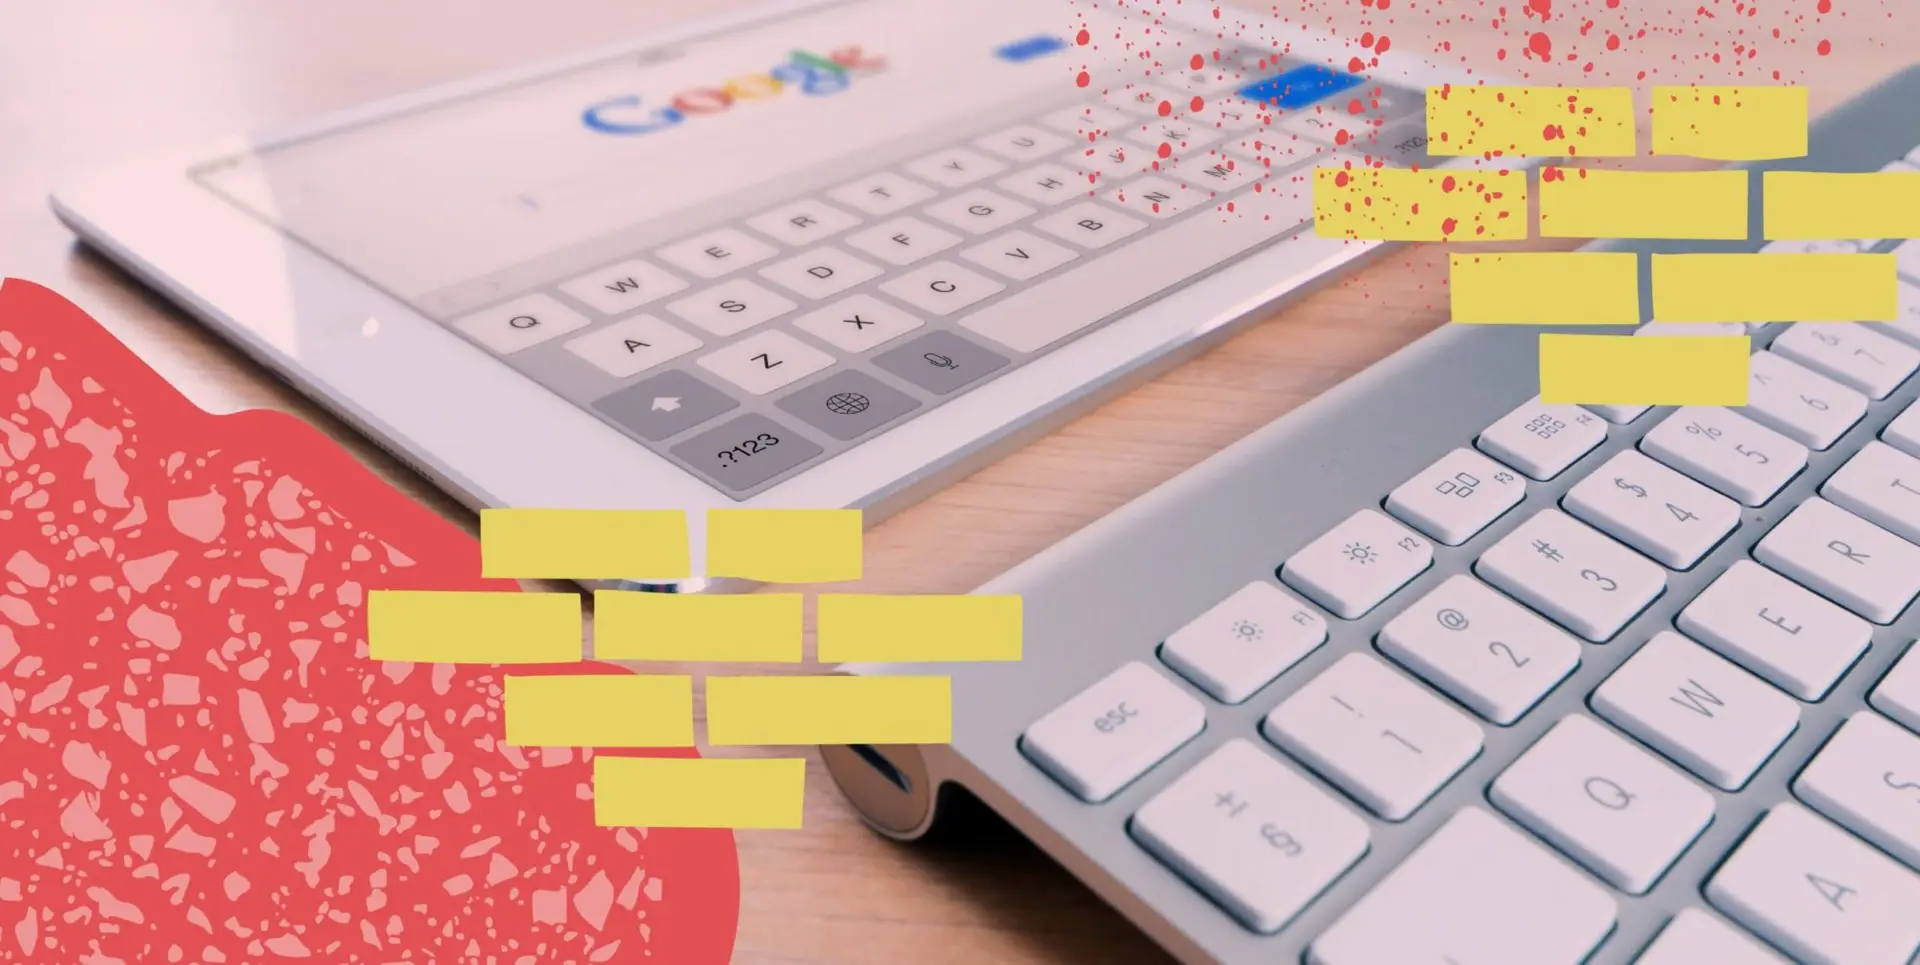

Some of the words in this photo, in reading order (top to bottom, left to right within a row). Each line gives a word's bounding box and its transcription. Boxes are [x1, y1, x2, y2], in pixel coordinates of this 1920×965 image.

[580, 46, 889, 135] Google
[1011, 136, 1035, 148] U
[1162, 129, 1188, 141] K
[943, 160, 964, 172] Y
[1202, 165, 1233, 179] M
[870, 187, 891, 199] T
[1036, 178, 1063, 190] H
[1143, 191, 1171, 203] N
[967, 204, 995, 217] G
[789, 215, 817, 229] R
[1076, 218, 1104, 232] B
[891, 232, 912, 247] F
[703, 245, 732, 260] E
[1004, 247, 1031, 262] V
[806, 265, 834, 280] D
[604, 275, 641, 296] W
[929, 280, 957, 294] C
[719, 299, 747, 314] S
[508, 314, 541, 330] Q
[842, 314, 875, 330] X
[623, 337, 651, 354] A
[750, 352, 783, 370] Z
[1854, 348, 1885, 366] 7
[1799, 393, 1830, 411] 6
[1684, 422, 1723, 442] %
[717, 432, 780, 468] .?123
[1734, 443, 1770, 465] 5
[1493, 471, 1515, 486] F3
[1613, 476, 1649, 498] $
[1664, 502, 1700, 523] 4
[1397, 536, 1422, 553] F2
[1531, 538, 1565, 564] #
[1827, 540, 1872, 565] R
[1580, 567, 1618, 592] 3
[1290, 611, 1315, 627] F1
[1435, 608, 1470, 631] @
[1757, 606, 1803, 636] E
[1488, 640, 1531, 668] 2
[1330, 694, 1365, 719] !
[1668, 678, 1725, 719] W
[1093, 700, 1140, 734] esc
[1381, 729, 1424, 755] 1
[1582, 776, 1637, 811] Q
[1259, 822, 1304, 858] §
[1803, 871, 1858, 913] A
